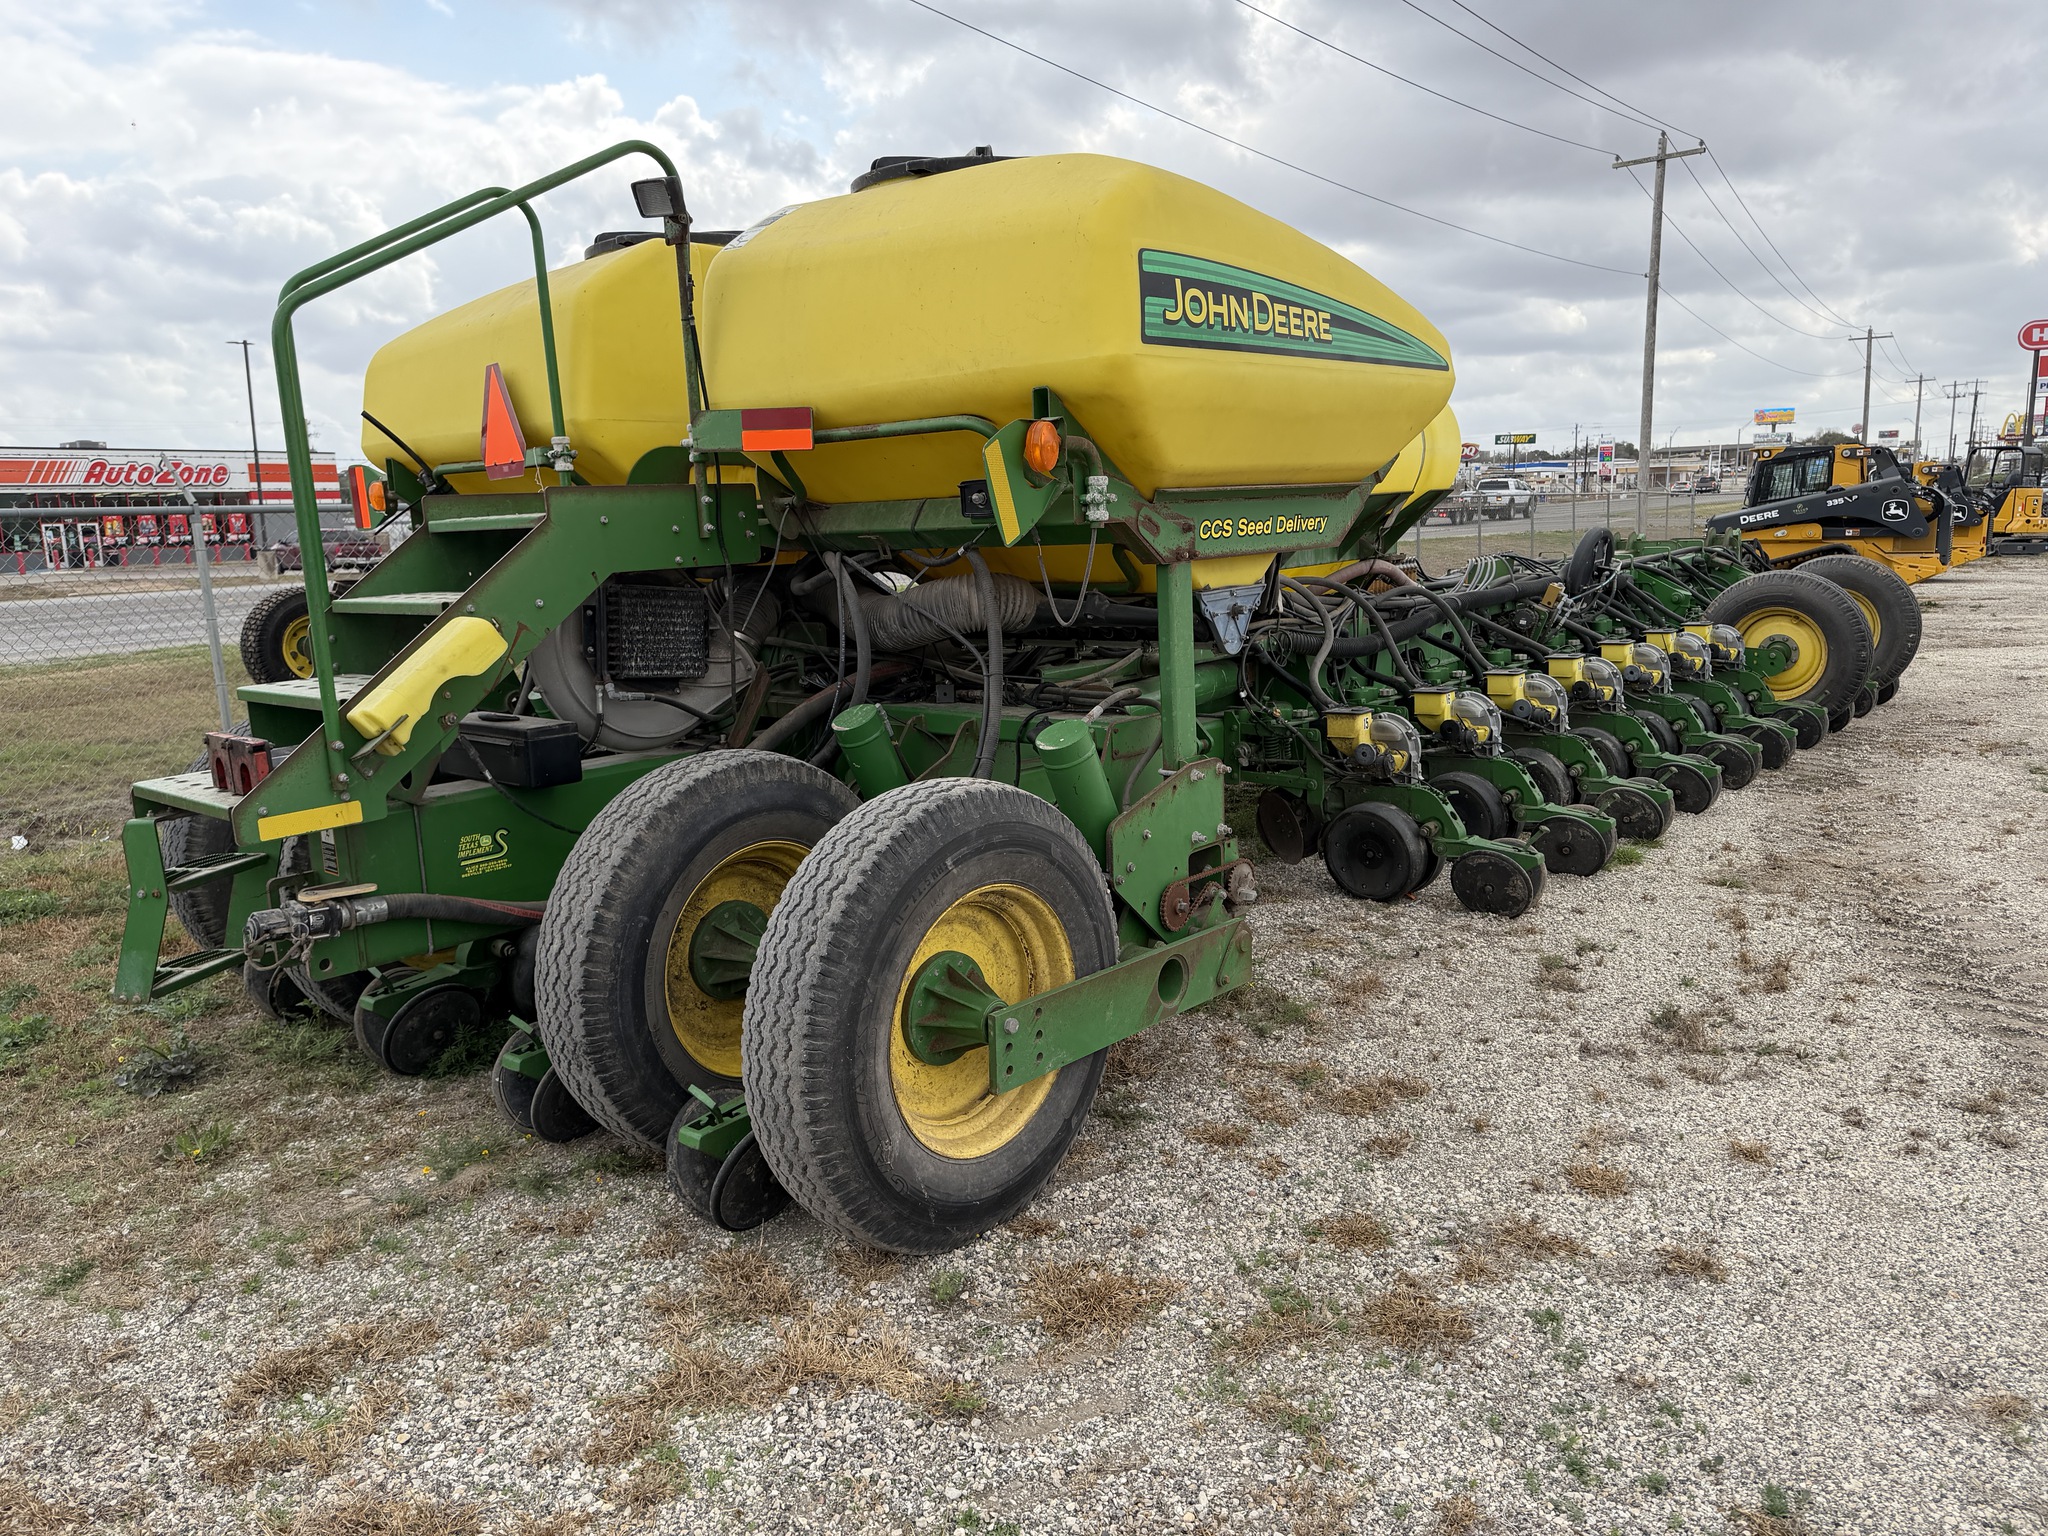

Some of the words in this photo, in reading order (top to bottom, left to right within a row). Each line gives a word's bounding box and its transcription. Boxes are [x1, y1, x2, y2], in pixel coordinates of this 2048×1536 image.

[1164, 278, 1250, 331] JOHN
[1252, 292, 1332, 341] DEERE
[83, 460, 229, 485] AutoZone
[1826, 497, 1844, 507] 335
[1740, 509, 1780, 525] DEERE
[1199, 519, 1234, 540] CCS
[1237, 516, 1273, 537] Seed
[1276, 514, 1329, 534] Delivery
[1363, 717, 1369, 730] 15
[460, 833, 481, 843] SOUTH
[457, 844, 494, 859] IMPLEMENT
[458, 841, 479, 851] TEXAS
